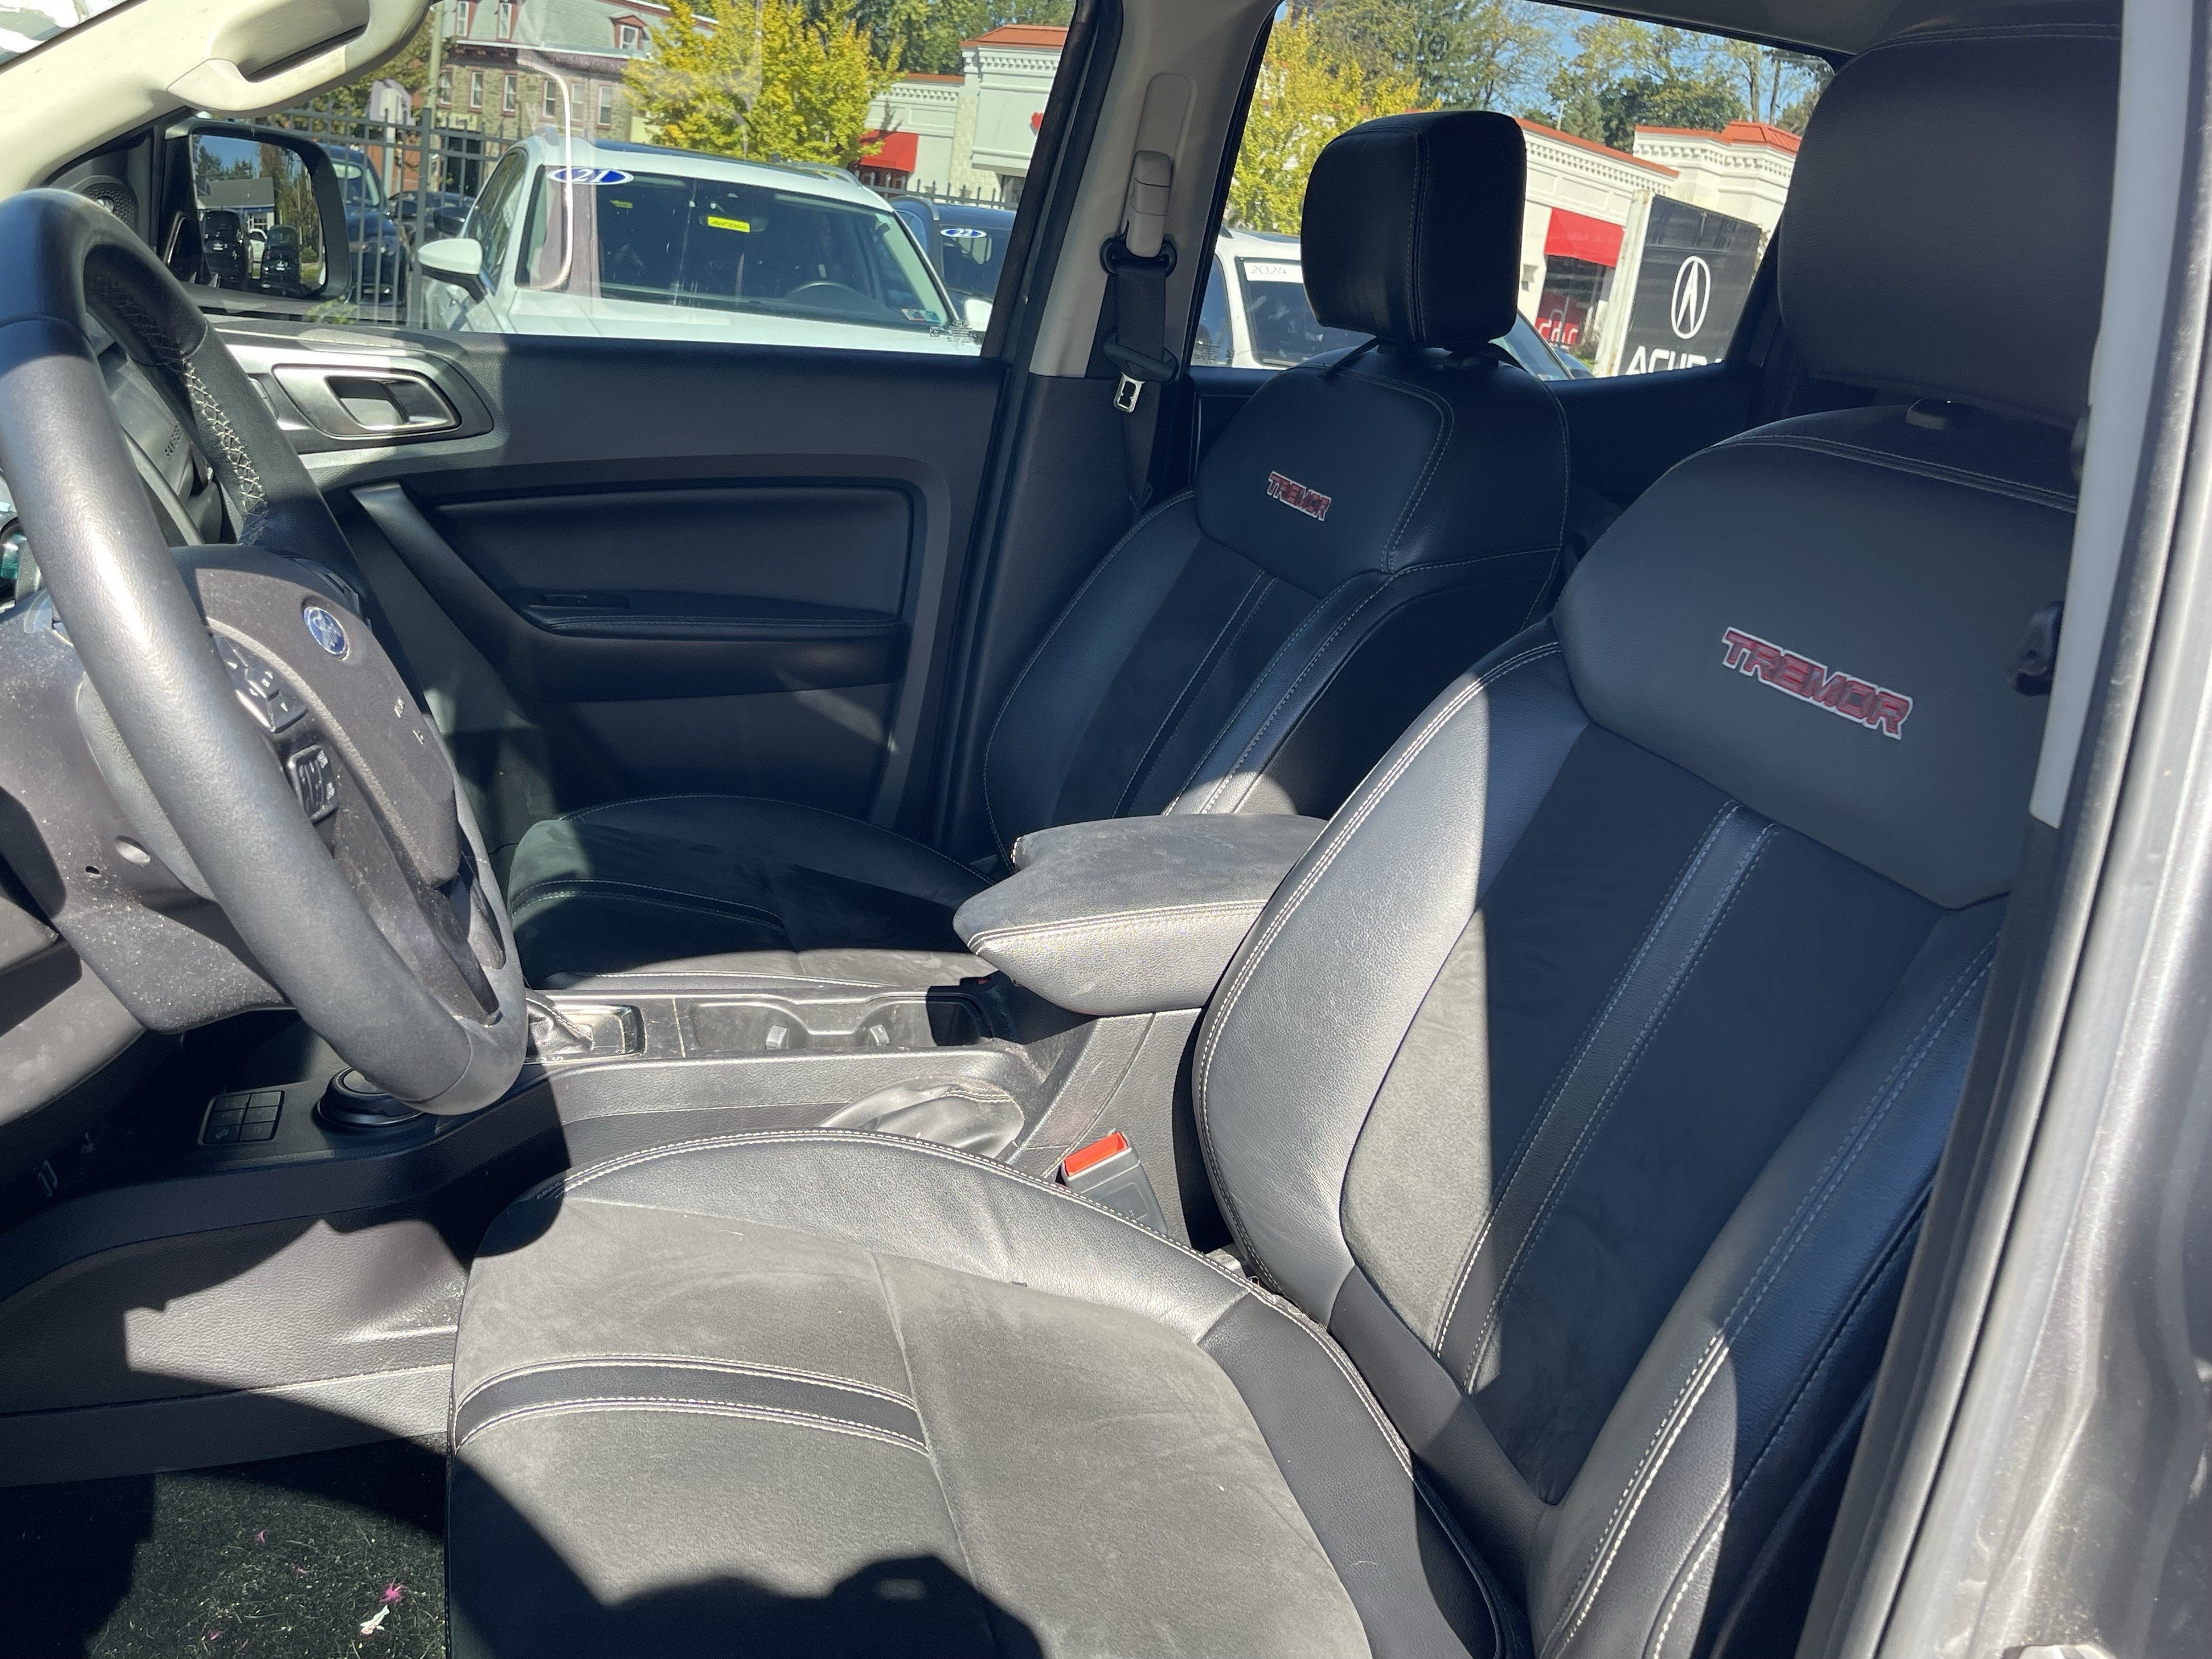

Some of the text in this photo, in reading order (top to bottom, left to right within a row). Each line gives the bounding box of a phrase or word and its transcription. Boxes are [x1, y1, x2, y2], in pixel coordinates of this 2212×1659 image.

[573, 168, 610, 183] 21
[953, 229, 973, 238] 22
[1251, 266, 1287, 274] 2024
[1625, 346, 1722, 375] ACU
[1266, 471, 1332, 521] TREMOR
[1720, 627, 1914, 740] TREMOR
